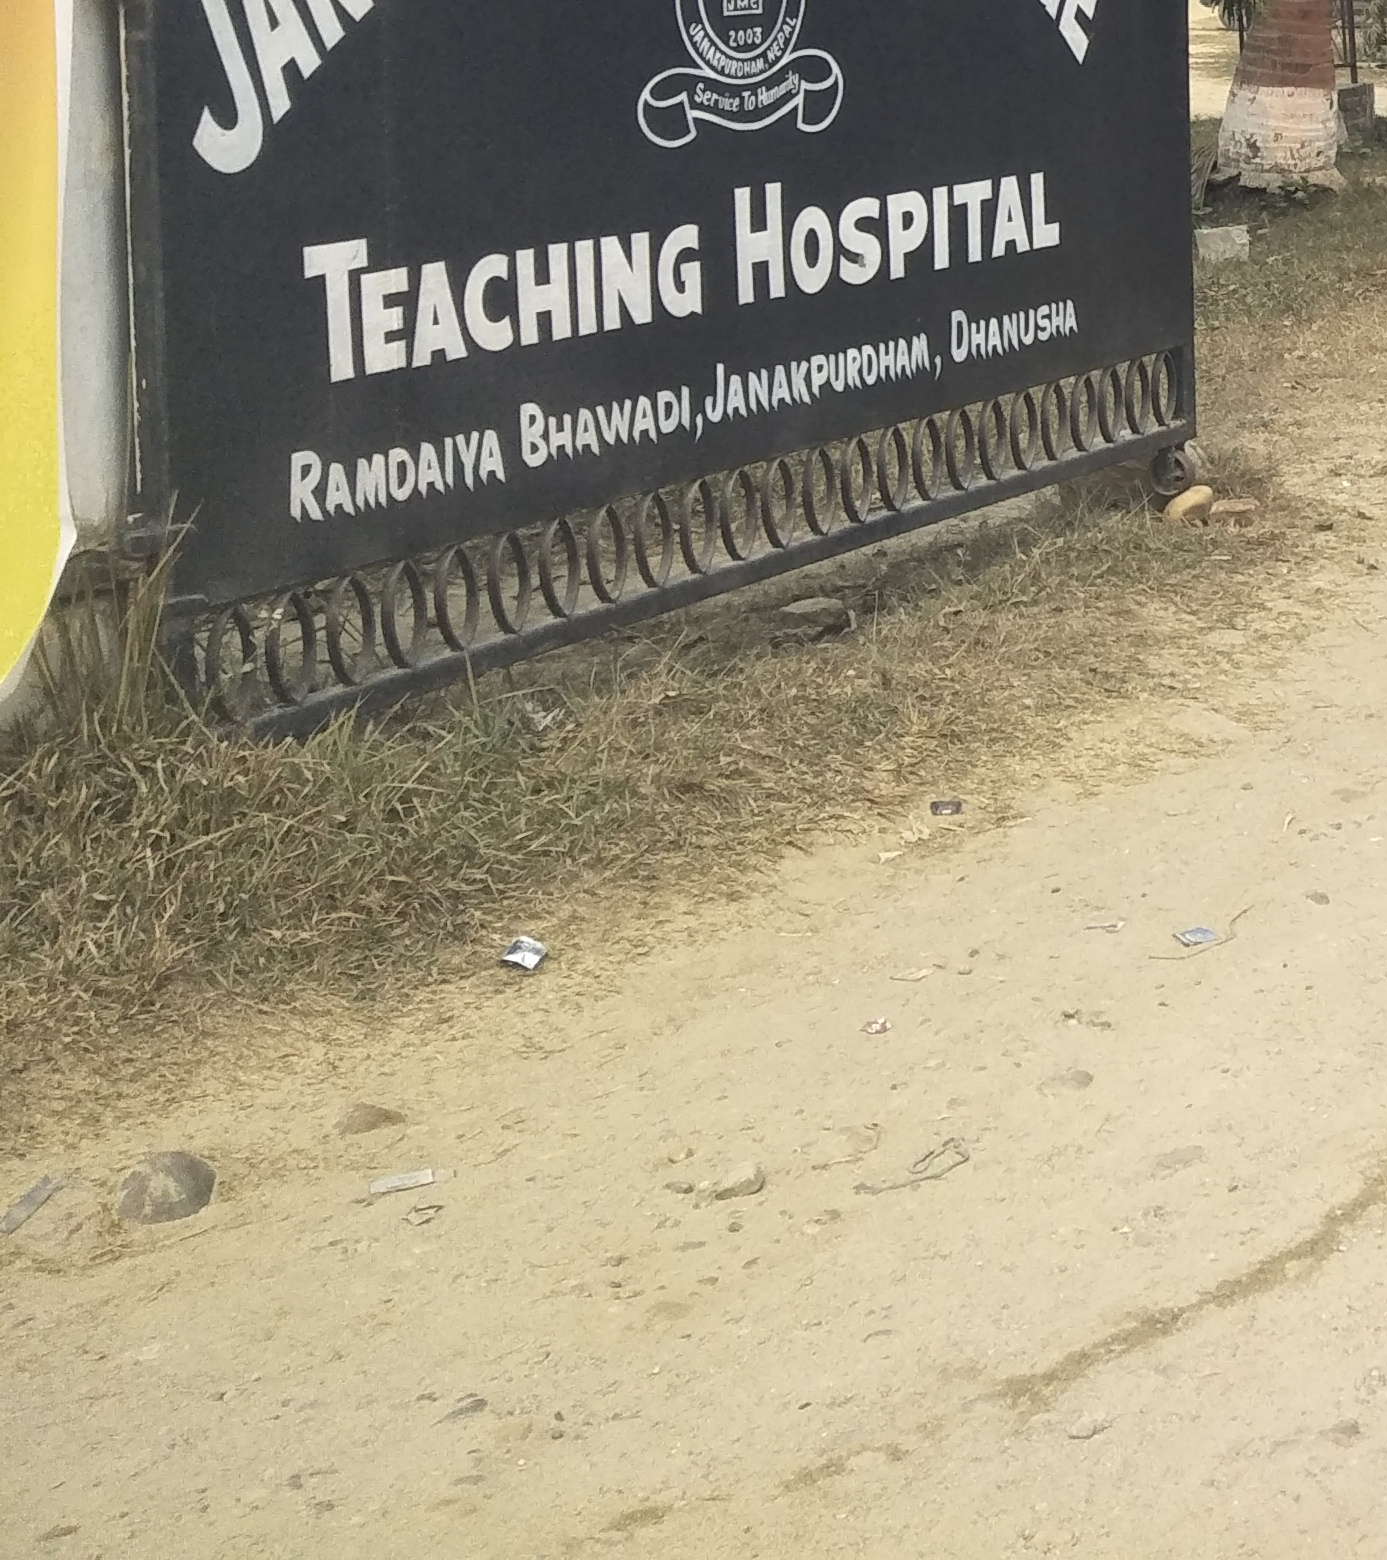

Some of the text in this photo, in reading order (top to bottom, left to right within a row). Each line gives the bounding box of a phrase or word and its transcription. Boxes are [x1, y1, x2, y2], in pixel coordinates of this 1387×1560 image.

[728, 26, 763, 48] 2003
[765, 16, 798, 64] NEPAL
[694, 70, 800, 113] Service To Humanity
[303, 171, 1061, 384] TEACHING HOSPITAL
[288, 428, 508, 524] RAMDAIYA
[949, 298, 1080, 364] DHANUSHA
